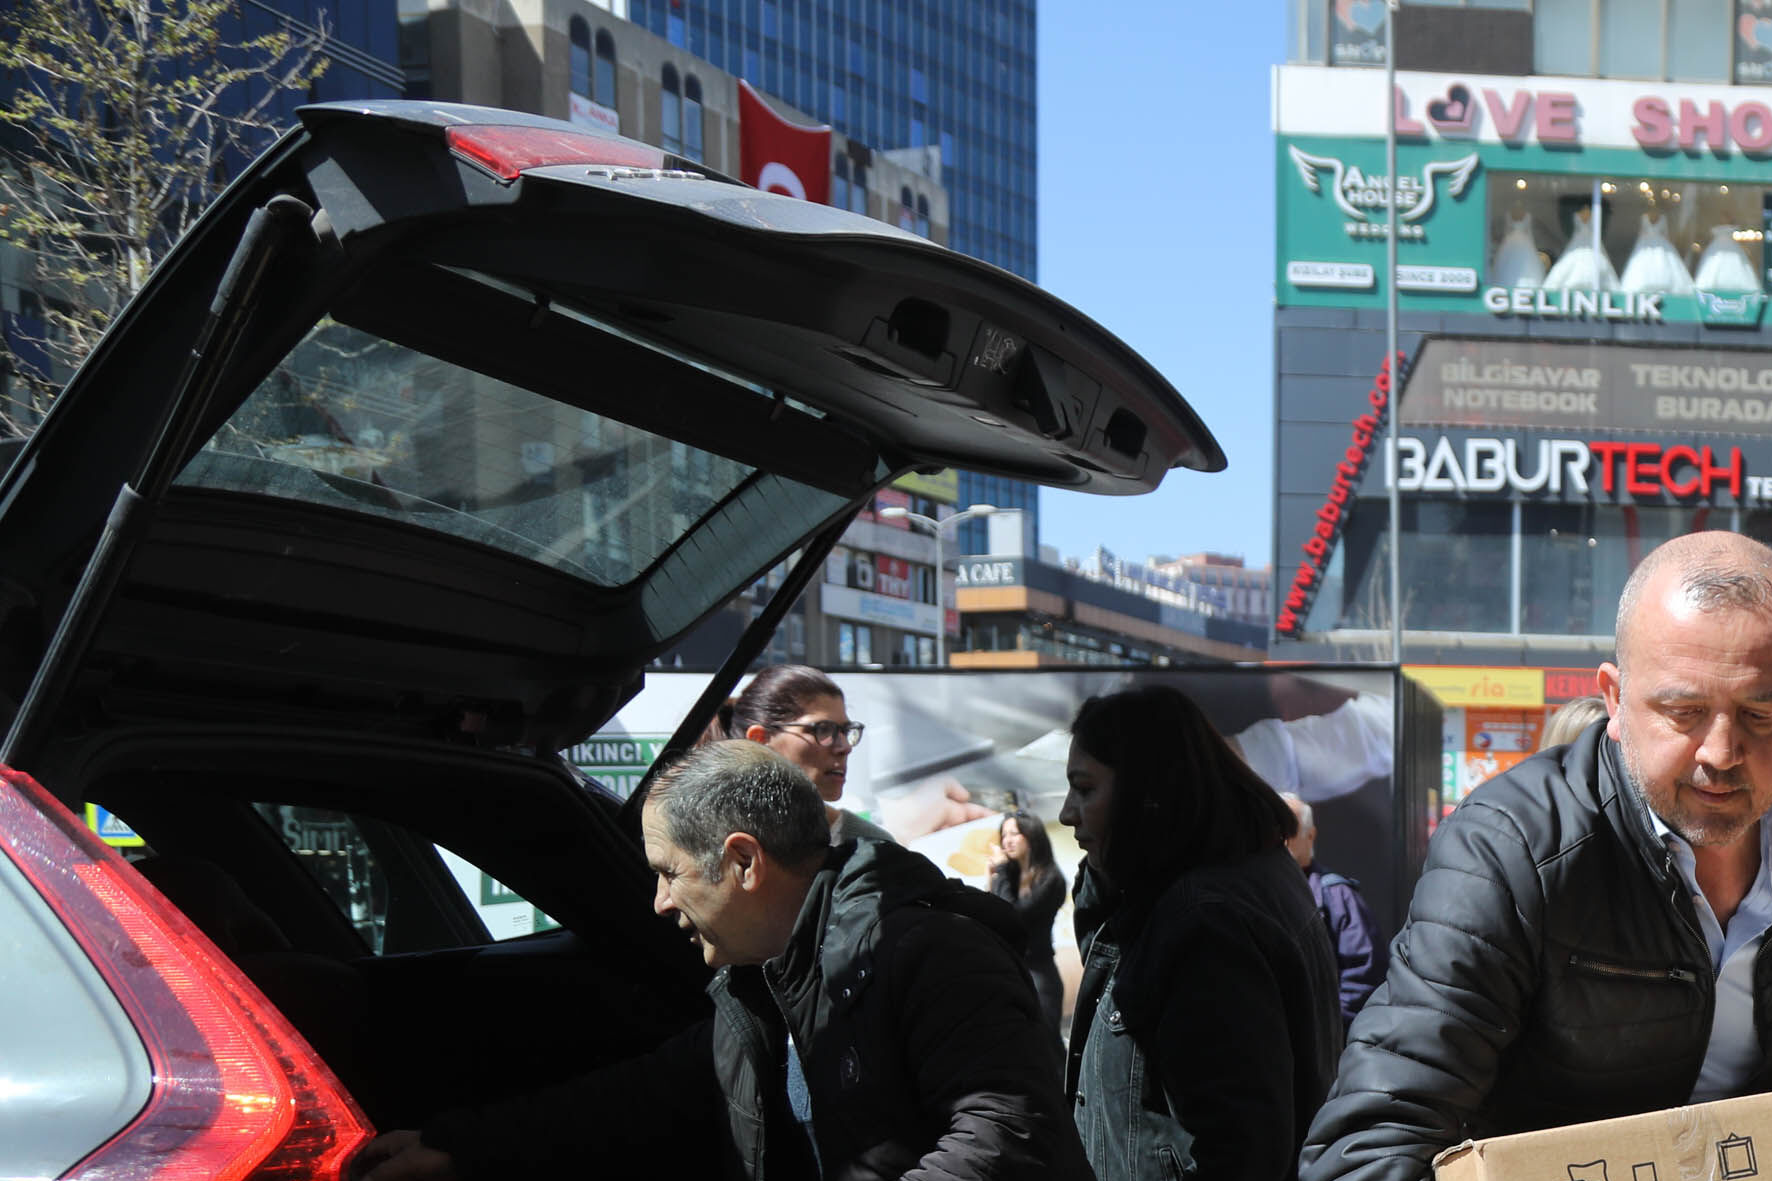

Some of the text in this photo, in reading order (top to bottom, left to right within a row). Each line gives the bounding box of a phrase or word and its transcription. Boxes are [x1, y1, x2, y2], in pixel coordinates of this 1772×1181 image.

[1342, 166, 1425, 192] ANEL
[1443, 388, 1598, 414] NOTEBOOK
[970, 562, 1015, 584] CAFE
